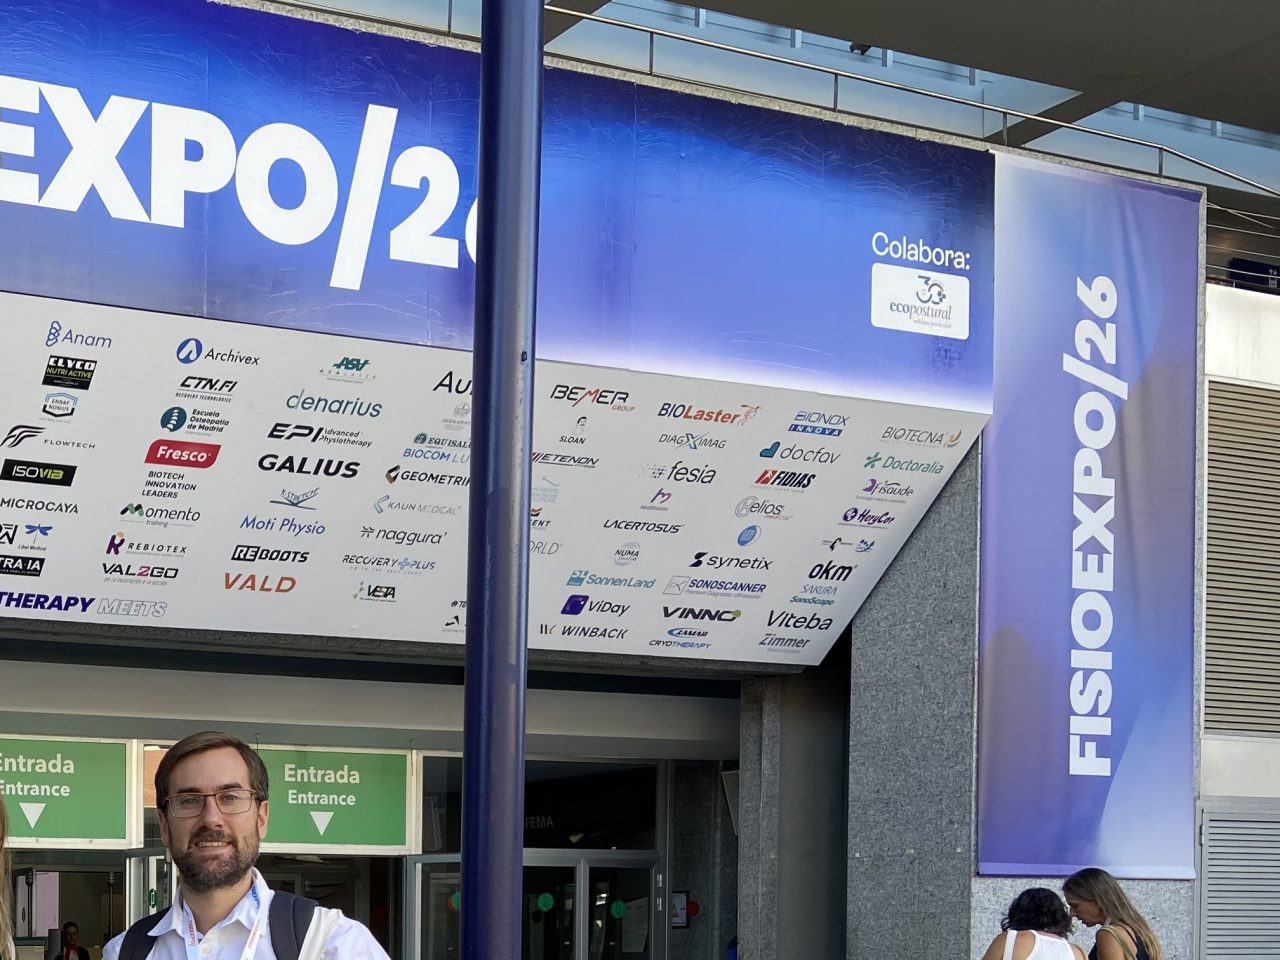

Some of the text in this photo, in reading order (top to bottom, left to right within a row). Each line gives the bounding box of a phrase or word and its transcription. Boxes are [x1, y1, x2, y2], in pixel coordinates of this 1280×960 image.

[872, 231, 971, 270] Colabora:
[890, 301, 952, 320] ecopostural
[62, 329, 112, 348] Anam
[204, 347, 261, 365] Archivex
[46, 367, 93, 379] NUTRI ACTIVE
[286, 388, 383, 418] denarius
[550, 385, 629, 407] BEMER
[192, 409, 220, 418] Escuela
[658, 402, 740, 424] BIOLaster
[794, 410, 850, 426] BIONOX
[198, 425, 224, 433] Madrid
[267, 422, 324, 443] EPI
[790, 424, 841, 436] INNOVA
[882, 426, 945, 445] BIOTECNA
[43, 439, 96, 449] FLOWTECH
[559, 435, 585, 445] SLOAN
[156, 446, 208, 462] Fresco
[403, 448, 450, 461] BIOCOM
[780, 444, 842, 464] docfav
[257, 453, 361, 478] GALIUS
[668, 461, 717, 484] fesia
[882, 456, 944, 474] Doctoralia
[148, 471, 185, 481] BIOTECH
[771, 471, 816, 488] FIDIAS
[141, 489, 178, 498] LEADERS
[145, 480, 197, 491] INNOVATION
[0, 497, 79, 514] MICROCAYA
[146, 519, 169, 528] training
[240, 515, 325, 536] Moti Physio
[604, 519, 681, 534] LACERTOSUS
[1063, 275, 1128, 776] FISIOEXPO/26
[128, 542, 188, 554] REBIOTEX
[615, 549, 639, 558] NUMA
[707, 555, 773, 570] synetix
[809, 560, 853, 581] okm
[225, 573, 296, 593] VALD
[689, 579, 767, 593] SONOSCANNER
[801, 584, 837, 595] SAKURA
[97, 598, 167, 618] MEETS
[588, 600, 631, 617] ViDay
[767, 610, 833, 630] Viteba
[561, 625, 628, 640] WINBACK
[759, 633, 810, 648] Zimmer
[649, 639, 712, 649] CRYOTHERAPY
[284, 764, 360, 785] Entrada
[287, 789, 356, 807] Entrance
